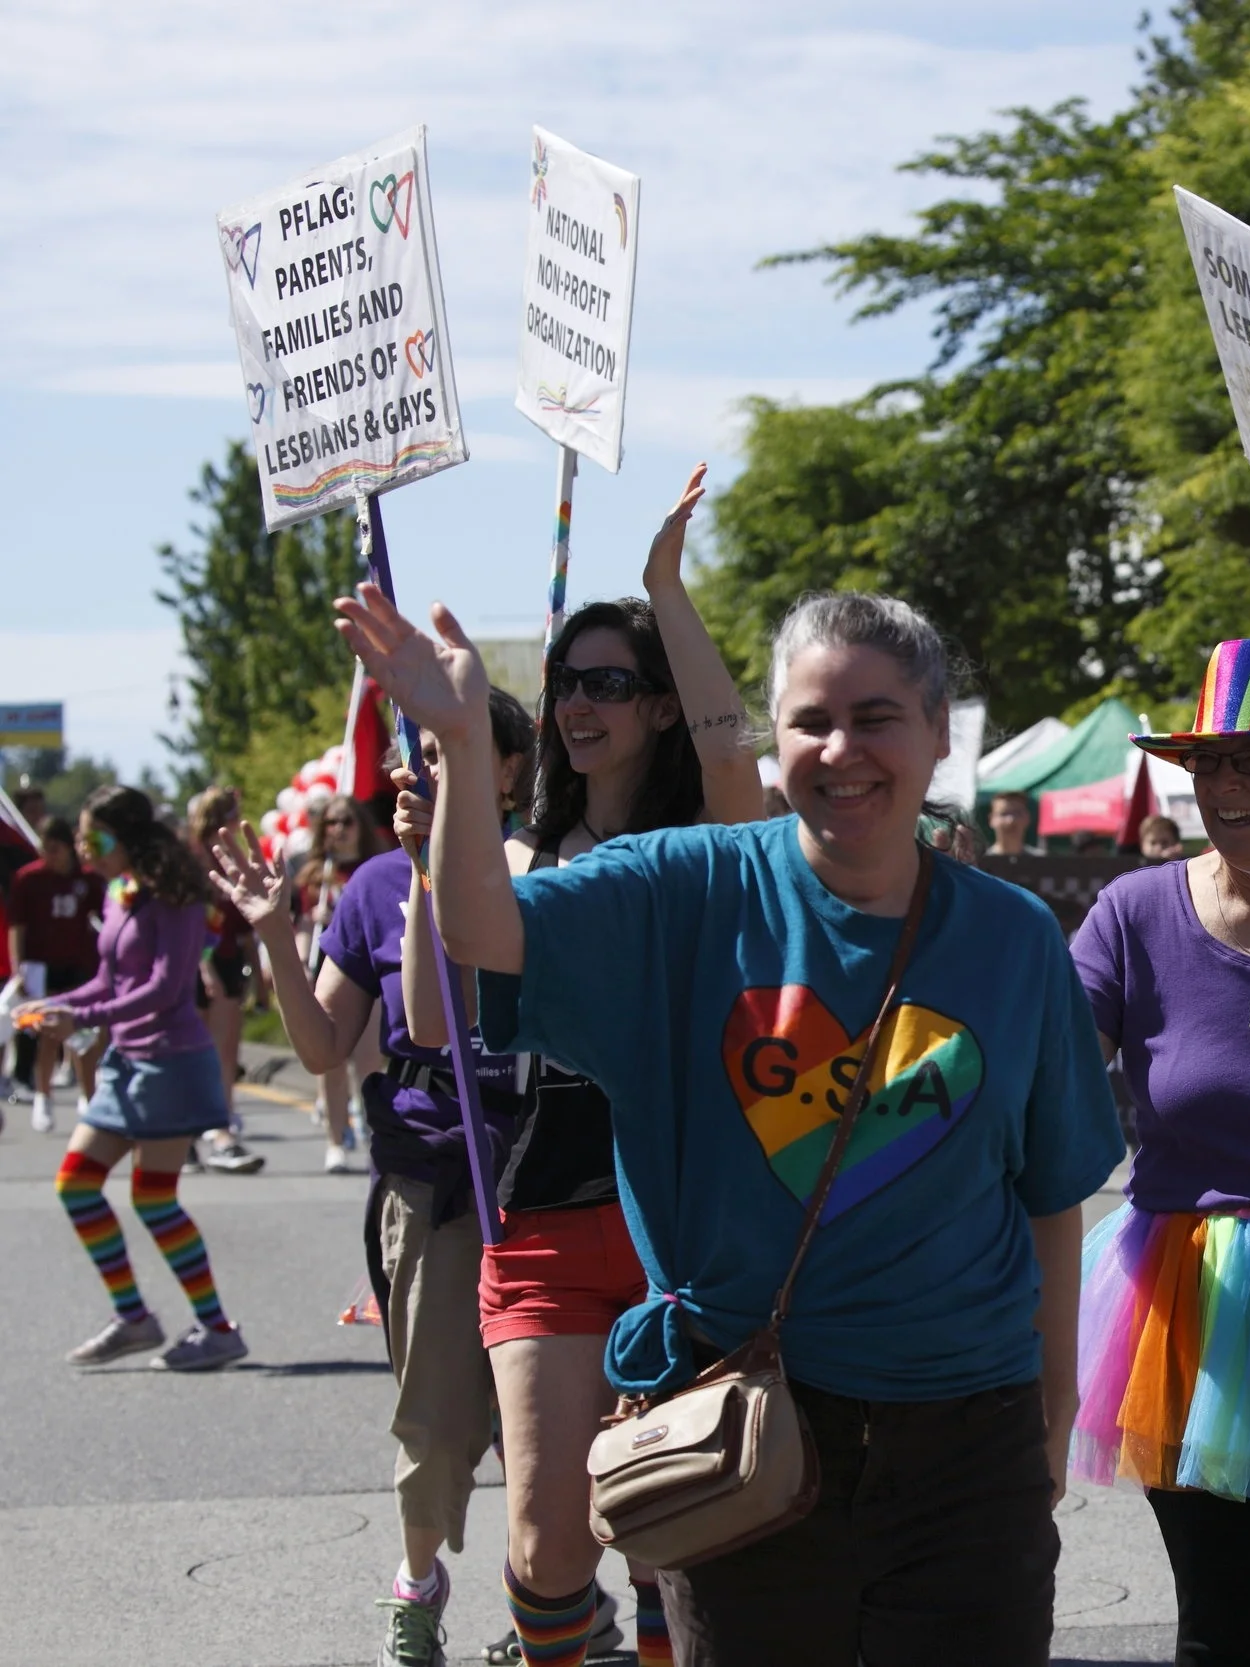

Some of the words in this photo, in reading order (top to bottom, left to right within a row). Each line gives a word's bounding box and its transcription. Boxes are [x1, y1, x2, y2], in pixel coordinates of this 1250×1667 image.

[279, 186, 355, 240] PFLAG:
[546, 205, 606, 265] NATIONAL
[275, 236, 373, 300] PARENTS,
[537, 254, 611, 322] NON-PROFIT
[262, 298, 352, 362] FAMILIES
[358, 282, 403, 328] AND
[527, 303, 616, 382] ORGANIZATION
[282, 350, 366, 412] FRIENDS
[371, 342, 398, 381] OF
[264, 413, 359, 475] LESBIANS
[364, 409, 382, 442] &
[383, 387, 436, 435] GAYS
